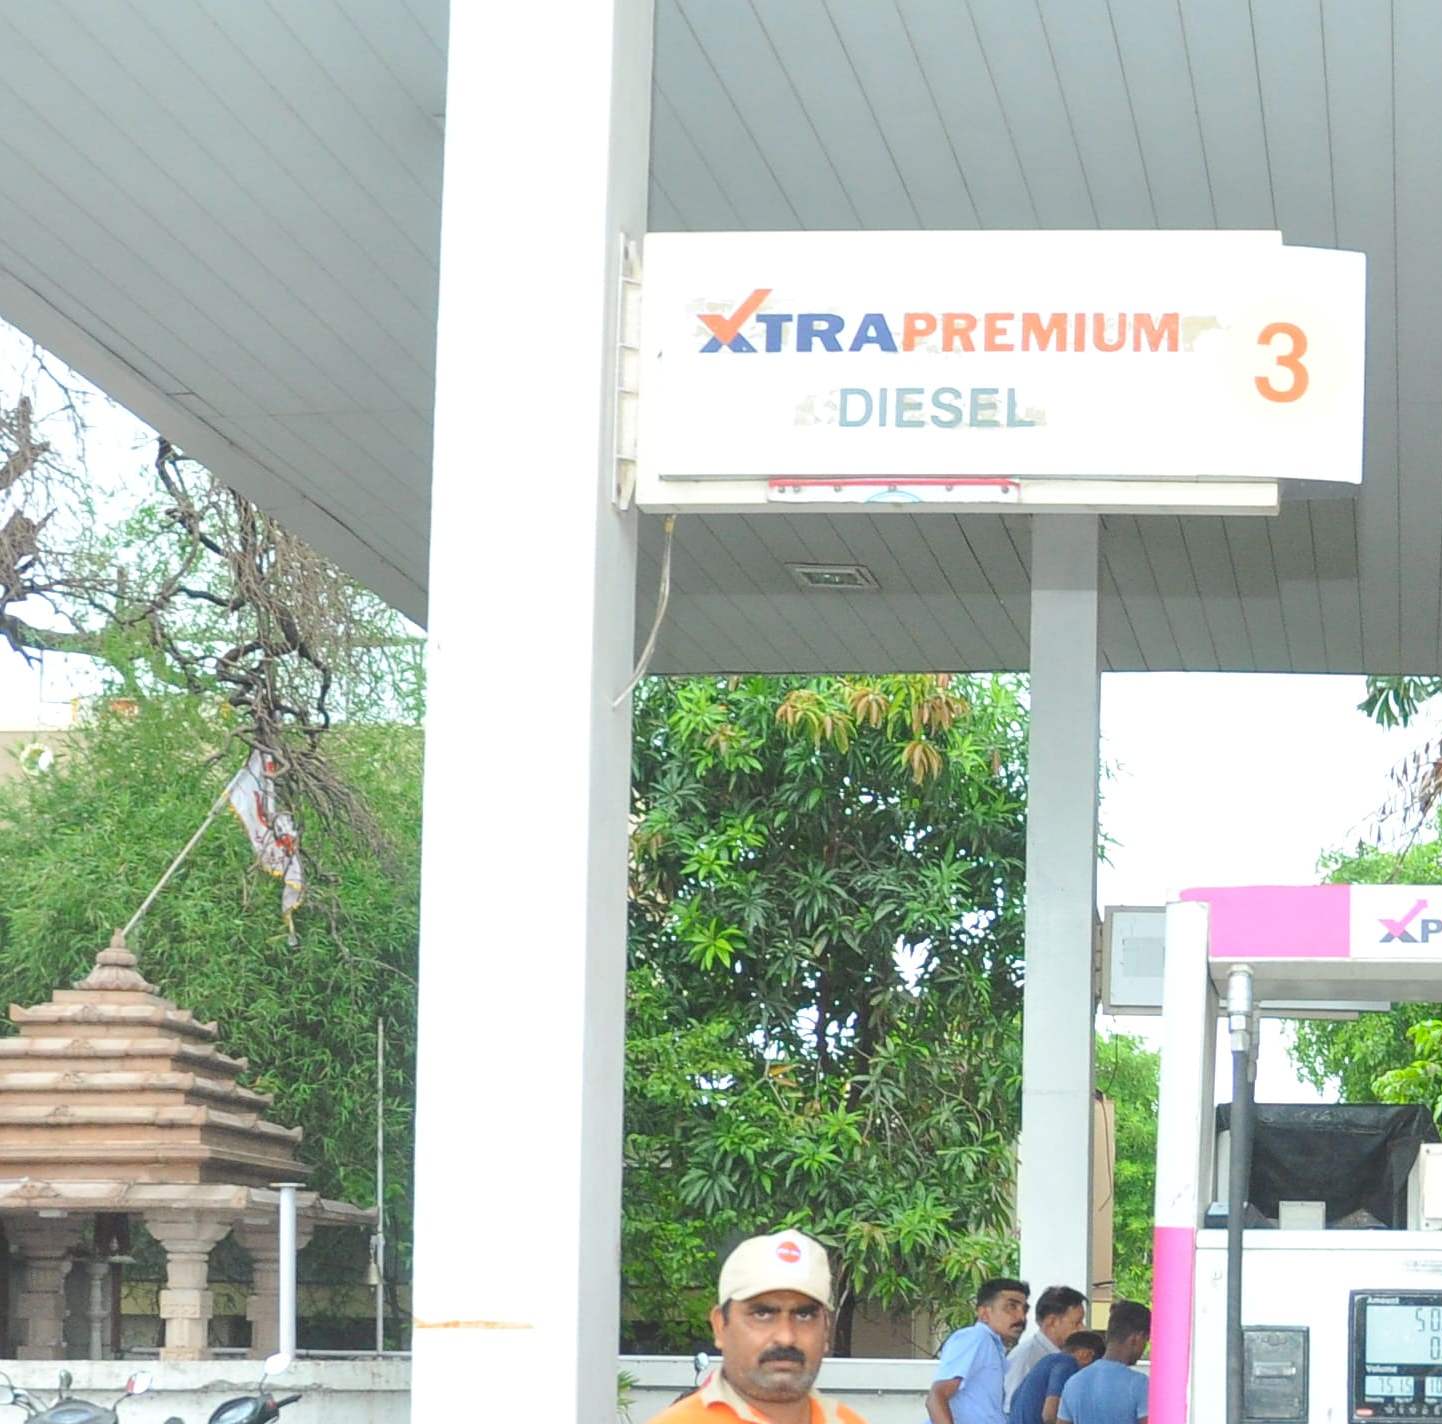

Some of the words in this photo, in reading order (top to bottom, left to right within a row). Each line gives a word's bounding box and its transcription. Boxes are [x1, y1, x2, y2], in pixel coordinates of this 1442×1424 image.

[697, 288, 1180, 353] XTRAPREMIUM
[1253, 321, 1310, 403] 3
[838, 387, 1035, 428] DIESEL
